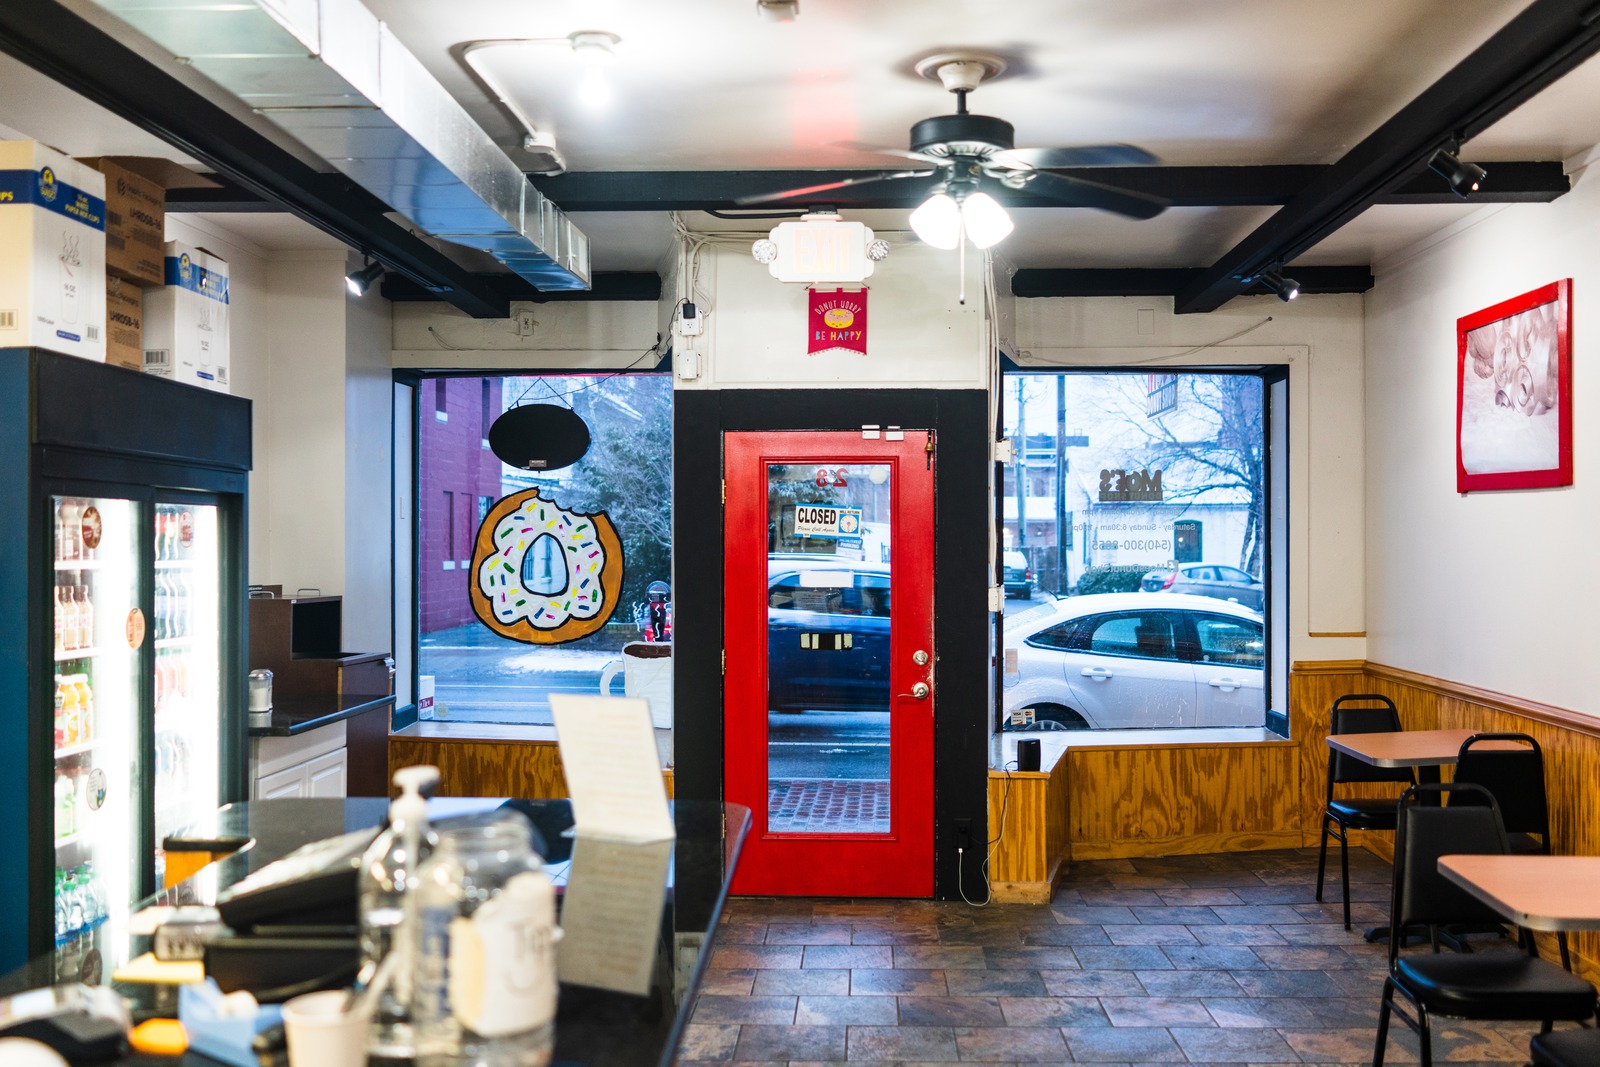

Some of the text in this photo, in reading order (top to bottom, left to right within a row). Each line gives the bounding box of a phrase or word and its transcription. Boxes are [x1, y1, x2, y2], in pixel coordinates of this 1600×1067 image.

[0, 191, 14, 201] PS
[795, 229, 854, 273] EXIT
[814, 300, 862, 315] DONUT WORRY
[816, 331, 862, 341] BE HAPPY
[798, 508, 837, 525] CLOSED
